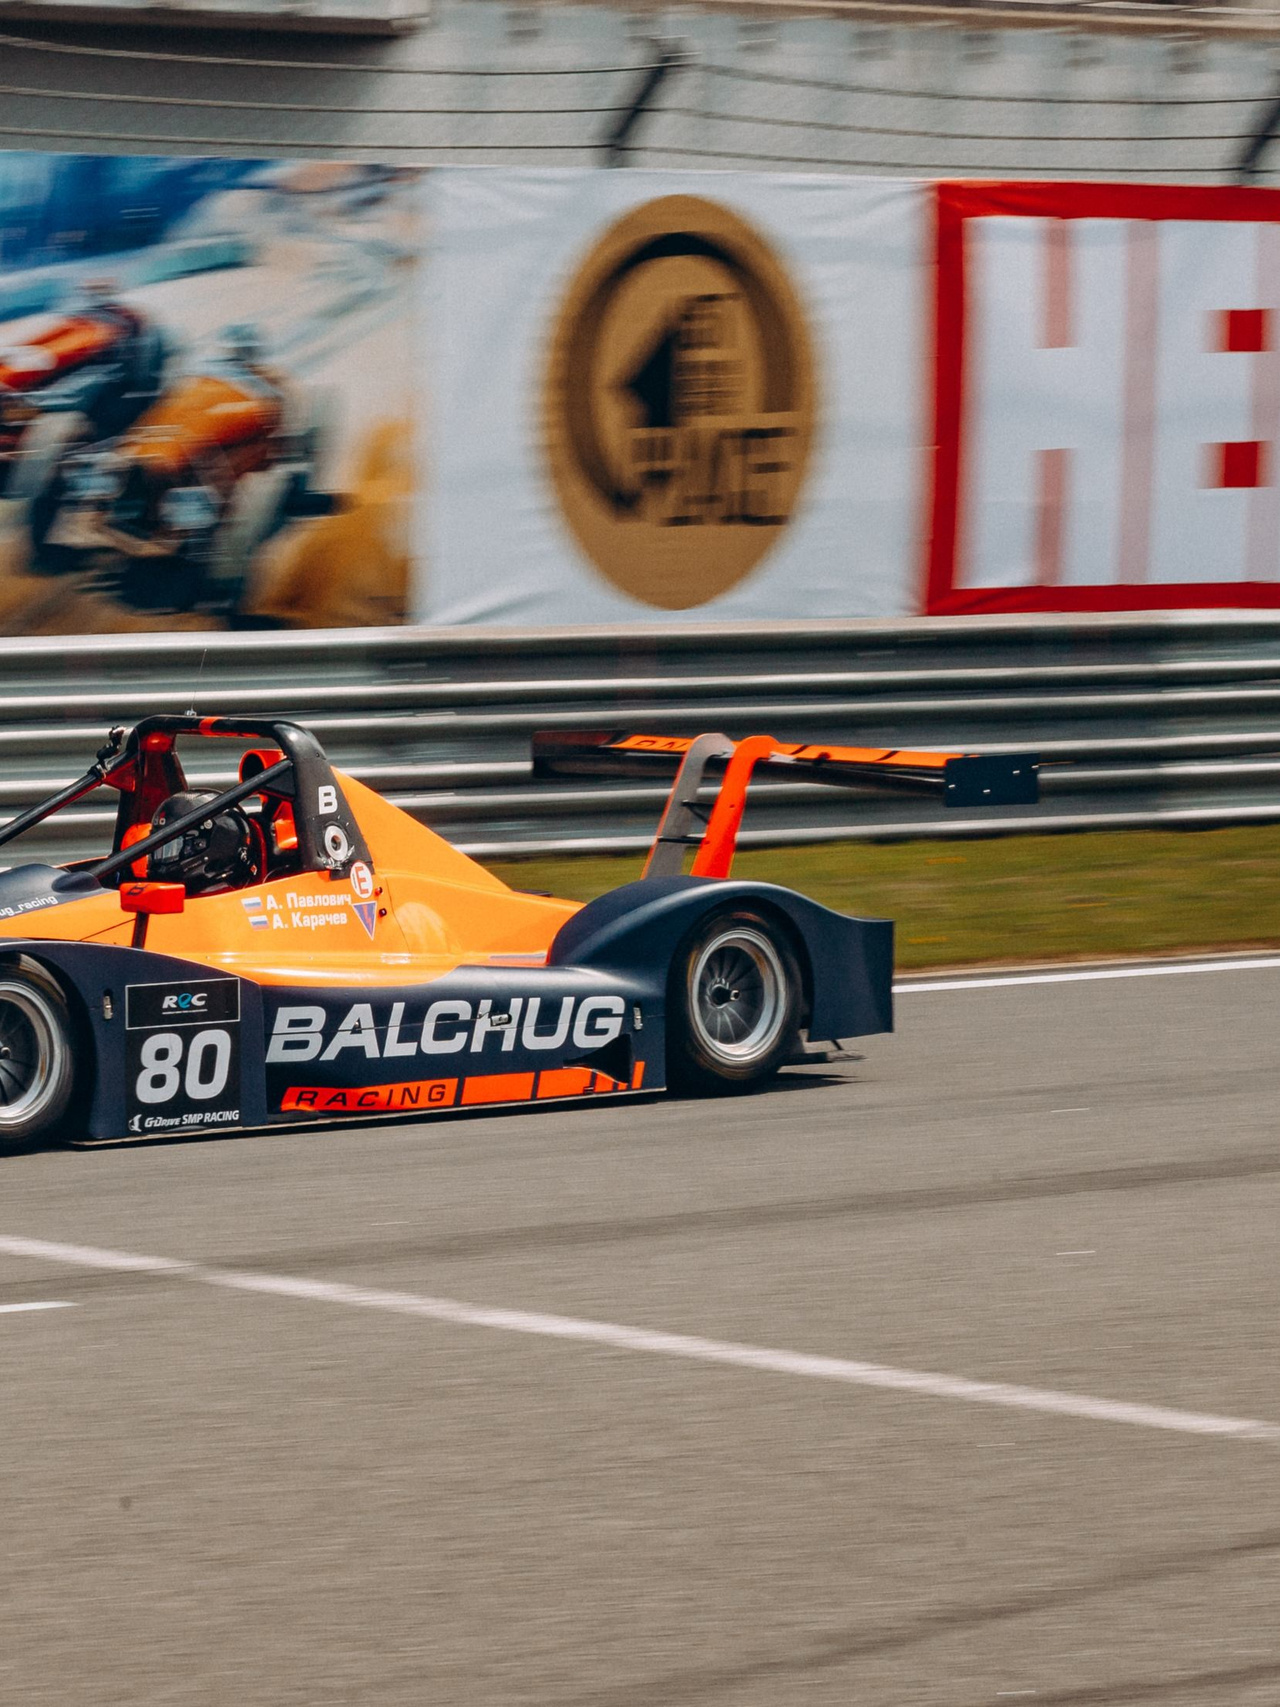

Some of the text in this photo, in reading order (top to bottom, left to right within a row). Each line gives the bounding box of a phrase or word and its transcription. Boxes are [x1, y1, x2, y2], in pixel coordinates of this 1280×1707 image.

[318, 785, 338, 815] B
[354, 866, 370, 895] E
[286, 892, 352, 909] Павлович
[291, 911, 348, 931] Карачев
[265, 996, 626, 1063] BALCHUG
[135, 1029, 231, 1104] 80
[295, 1084, 447, 1107] RACING
[182, 1113, 204, 1125] SMP
[203, 1110, 240, 1123] RACING
